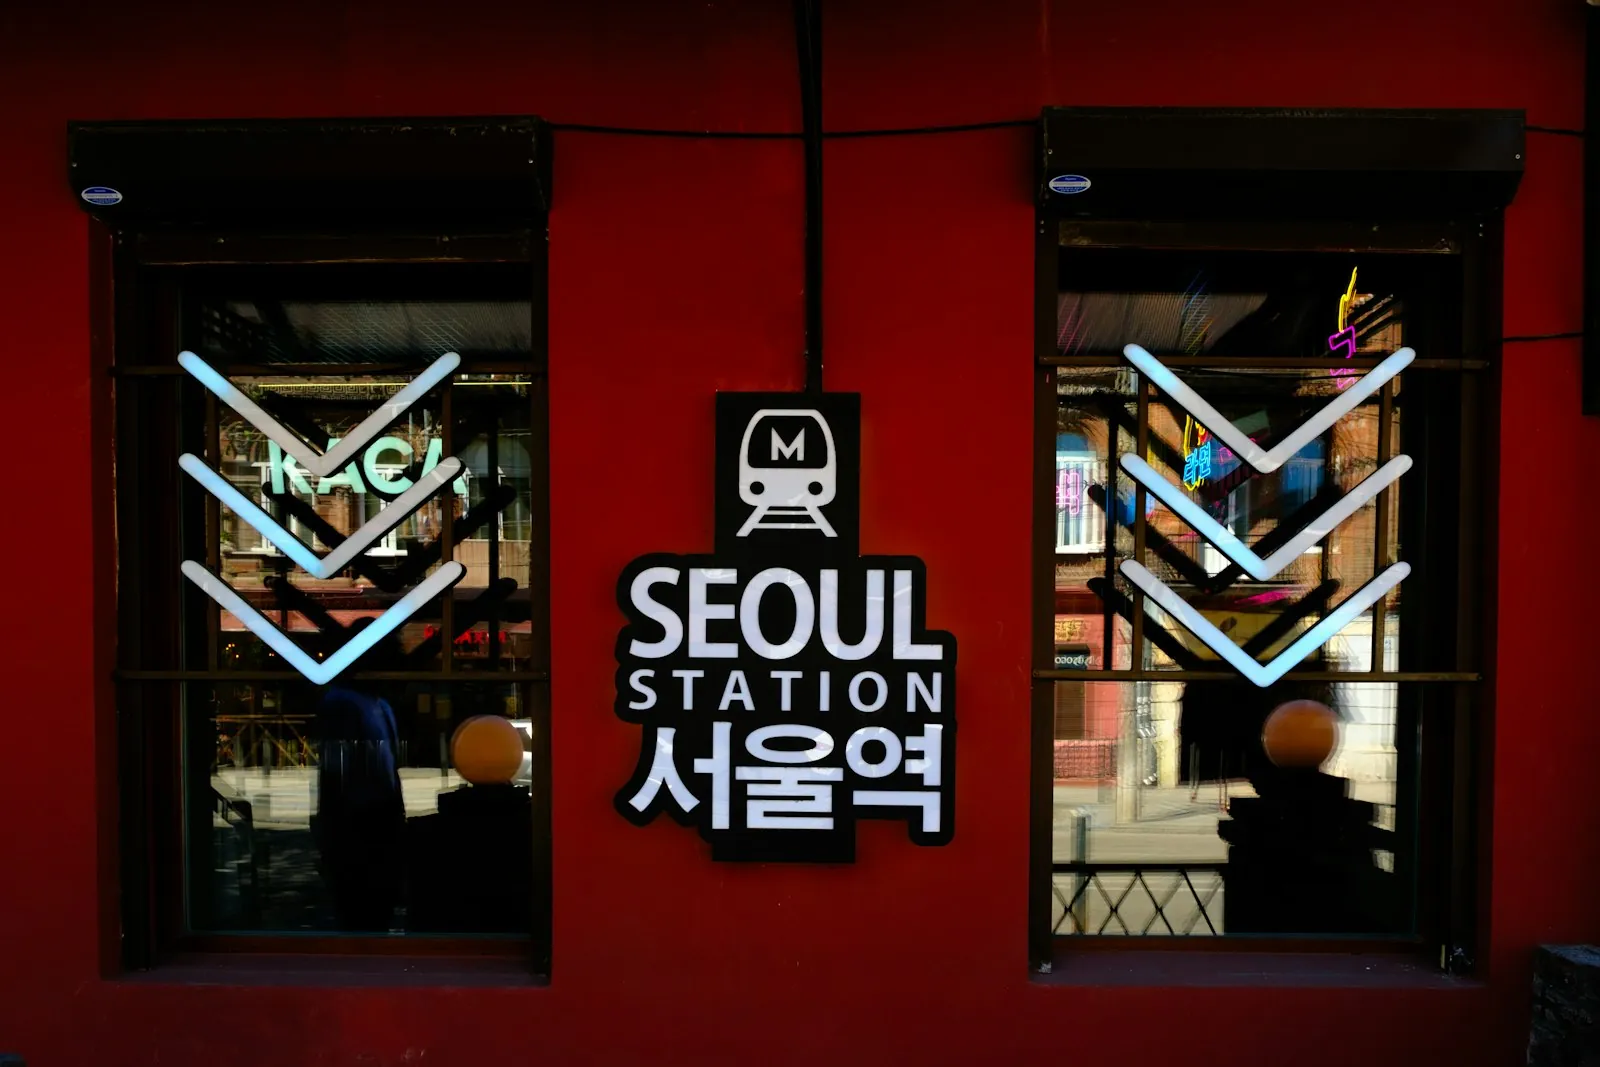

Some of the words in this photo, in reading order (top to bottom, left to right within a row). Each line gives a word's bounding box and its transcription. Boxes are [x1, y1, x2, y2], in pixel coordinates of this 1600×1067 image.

[628, 566, 944, 661] SEOUL
[627, 669, 943, 713] STATION
[627, 721, 944, 833] 서울역
